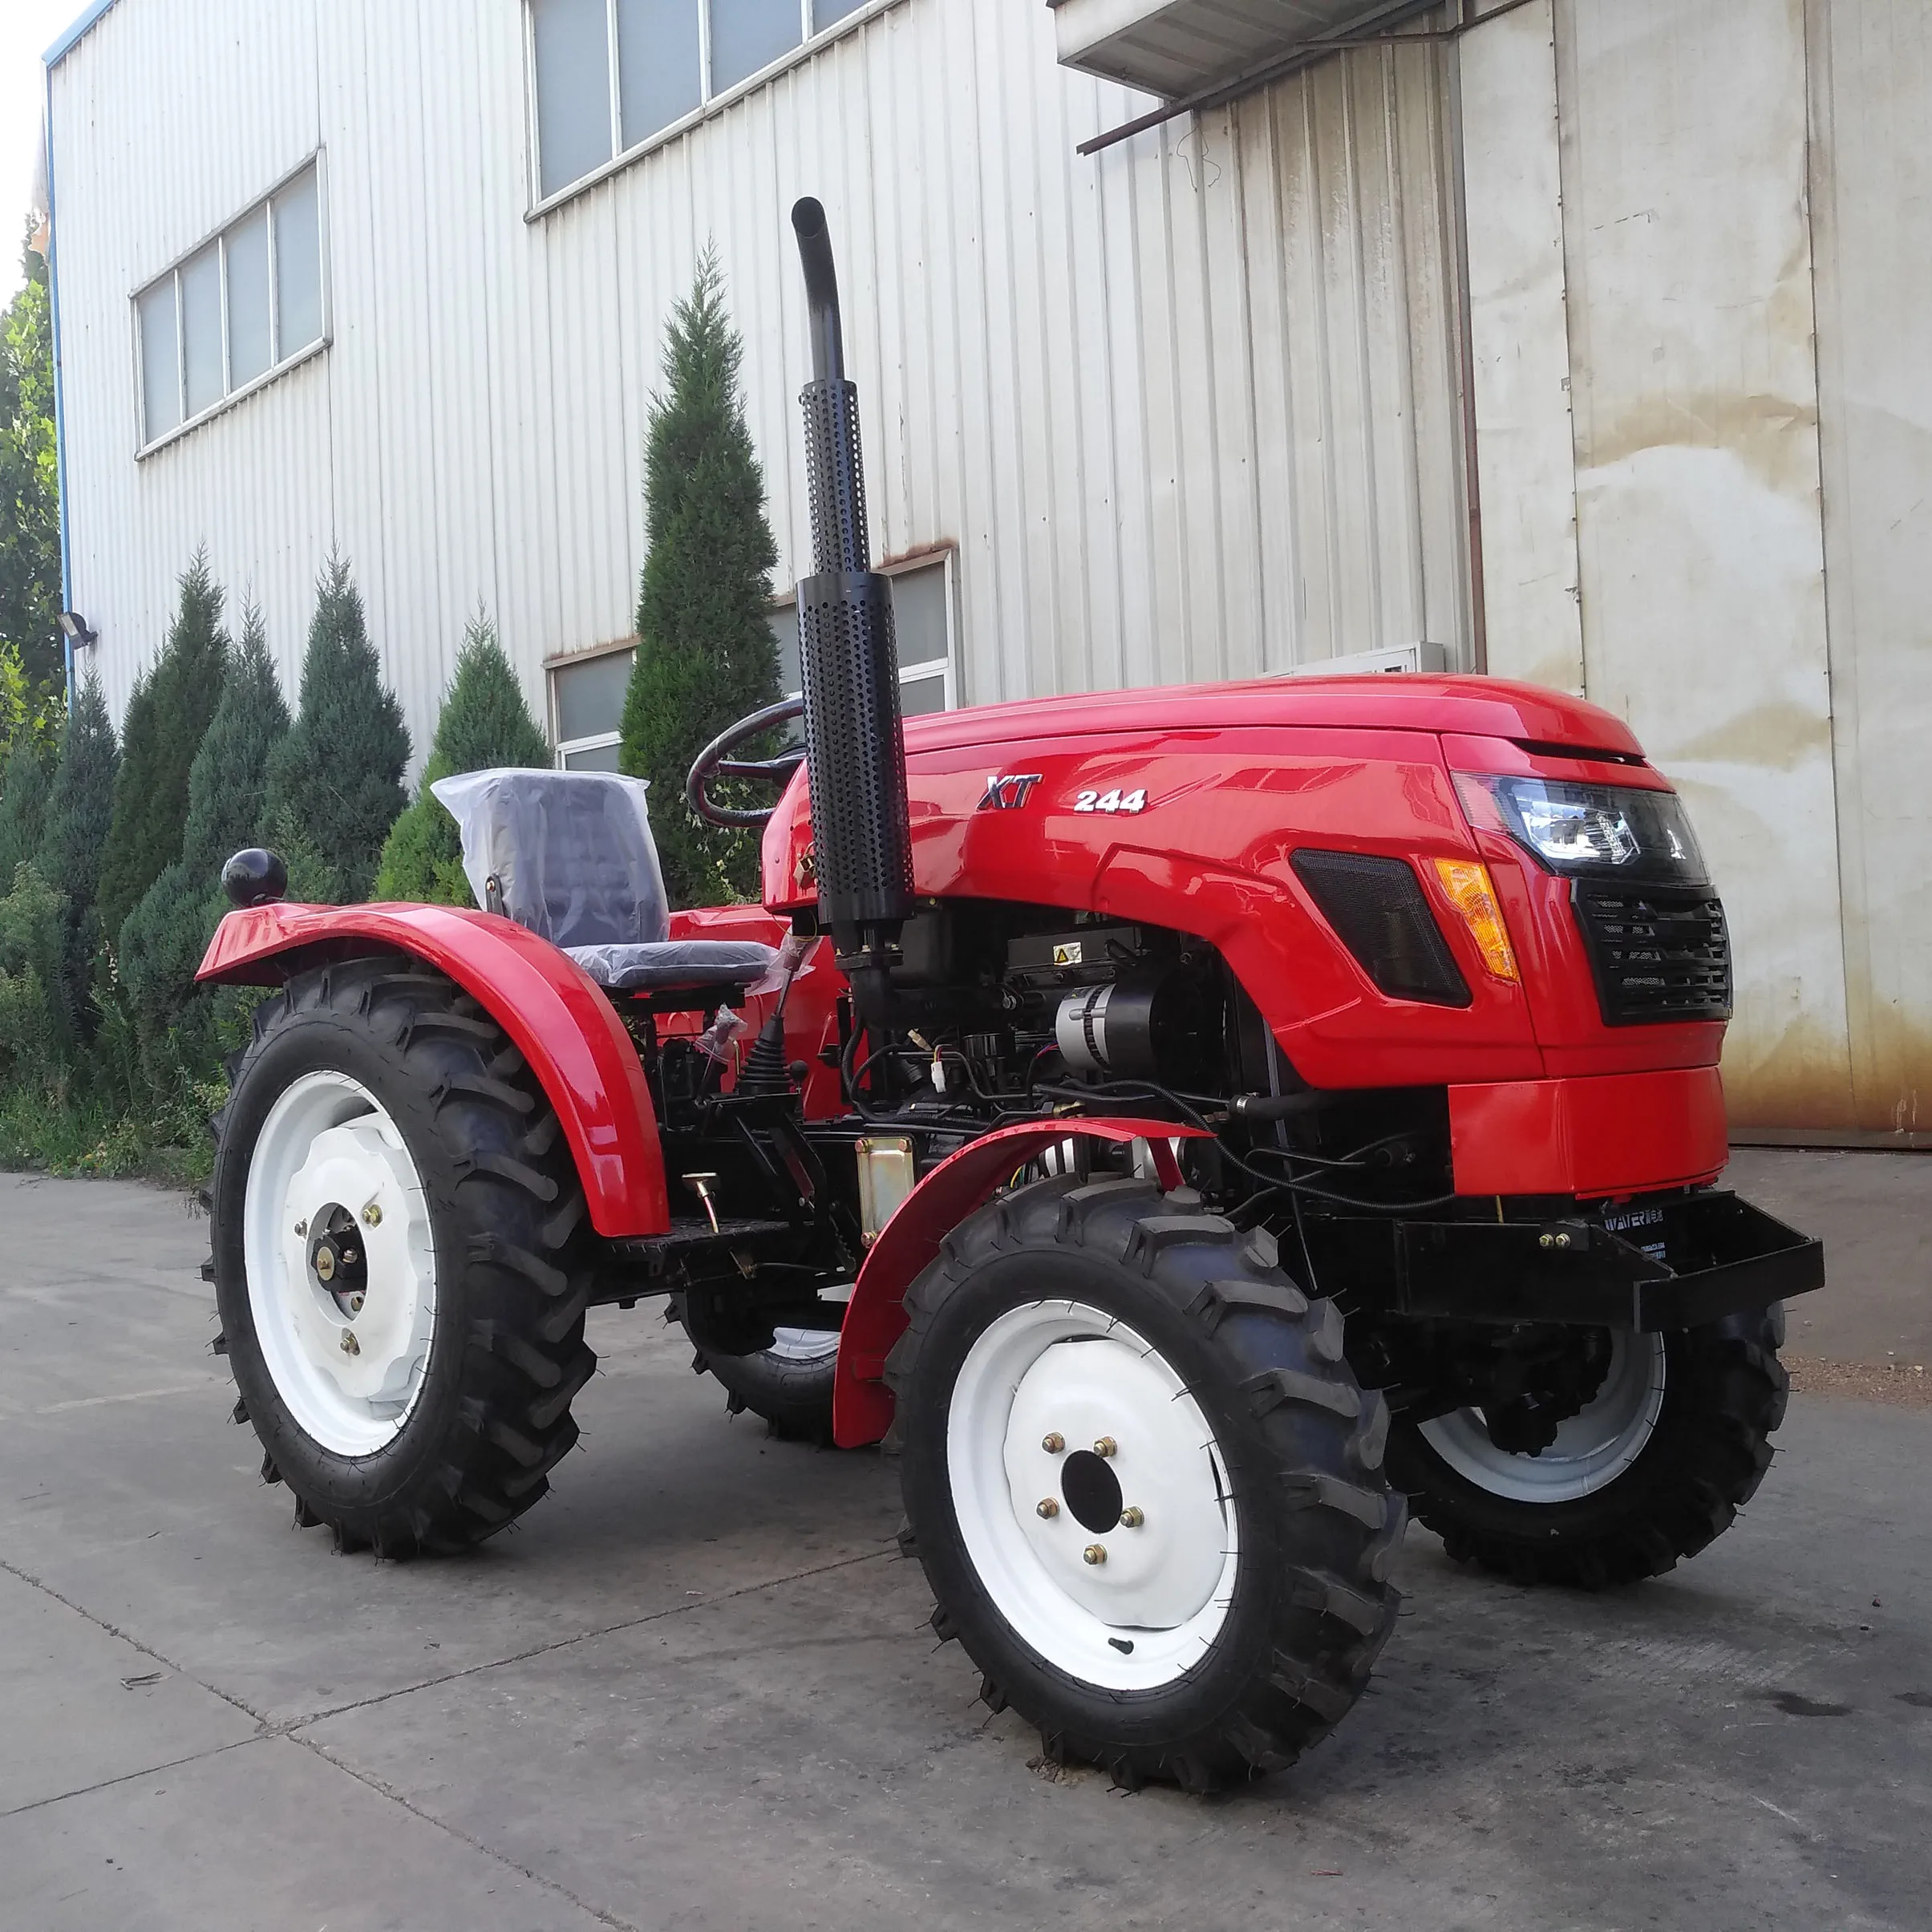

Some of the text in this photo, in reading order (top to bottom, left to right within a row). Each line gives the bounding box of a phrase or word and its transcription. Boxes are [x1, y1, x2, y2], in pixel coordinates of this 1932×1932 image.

[976, 774, 1147, 813] XT 244
[1604, 1211, 1645, 1231] WATER
